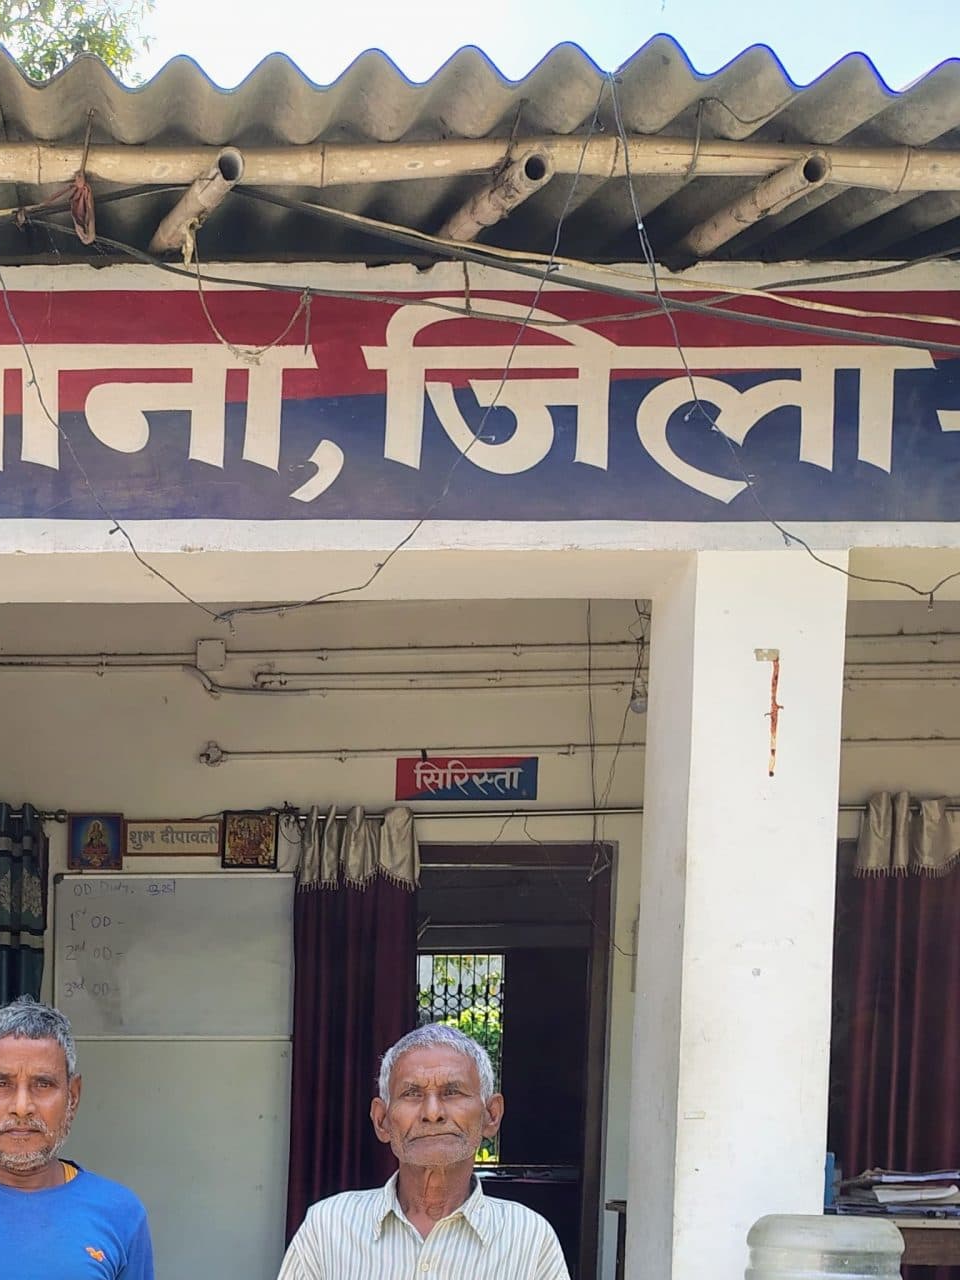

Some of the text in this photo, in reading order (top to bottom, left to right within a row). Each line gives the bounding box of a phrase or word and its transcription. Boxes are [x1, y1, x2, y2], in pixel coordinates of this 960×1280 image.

[361, 297, 936, 504] जिला
[413, 760, 524, 796] सिरिस्ता
[129, 830, 155, 850] शुभ
